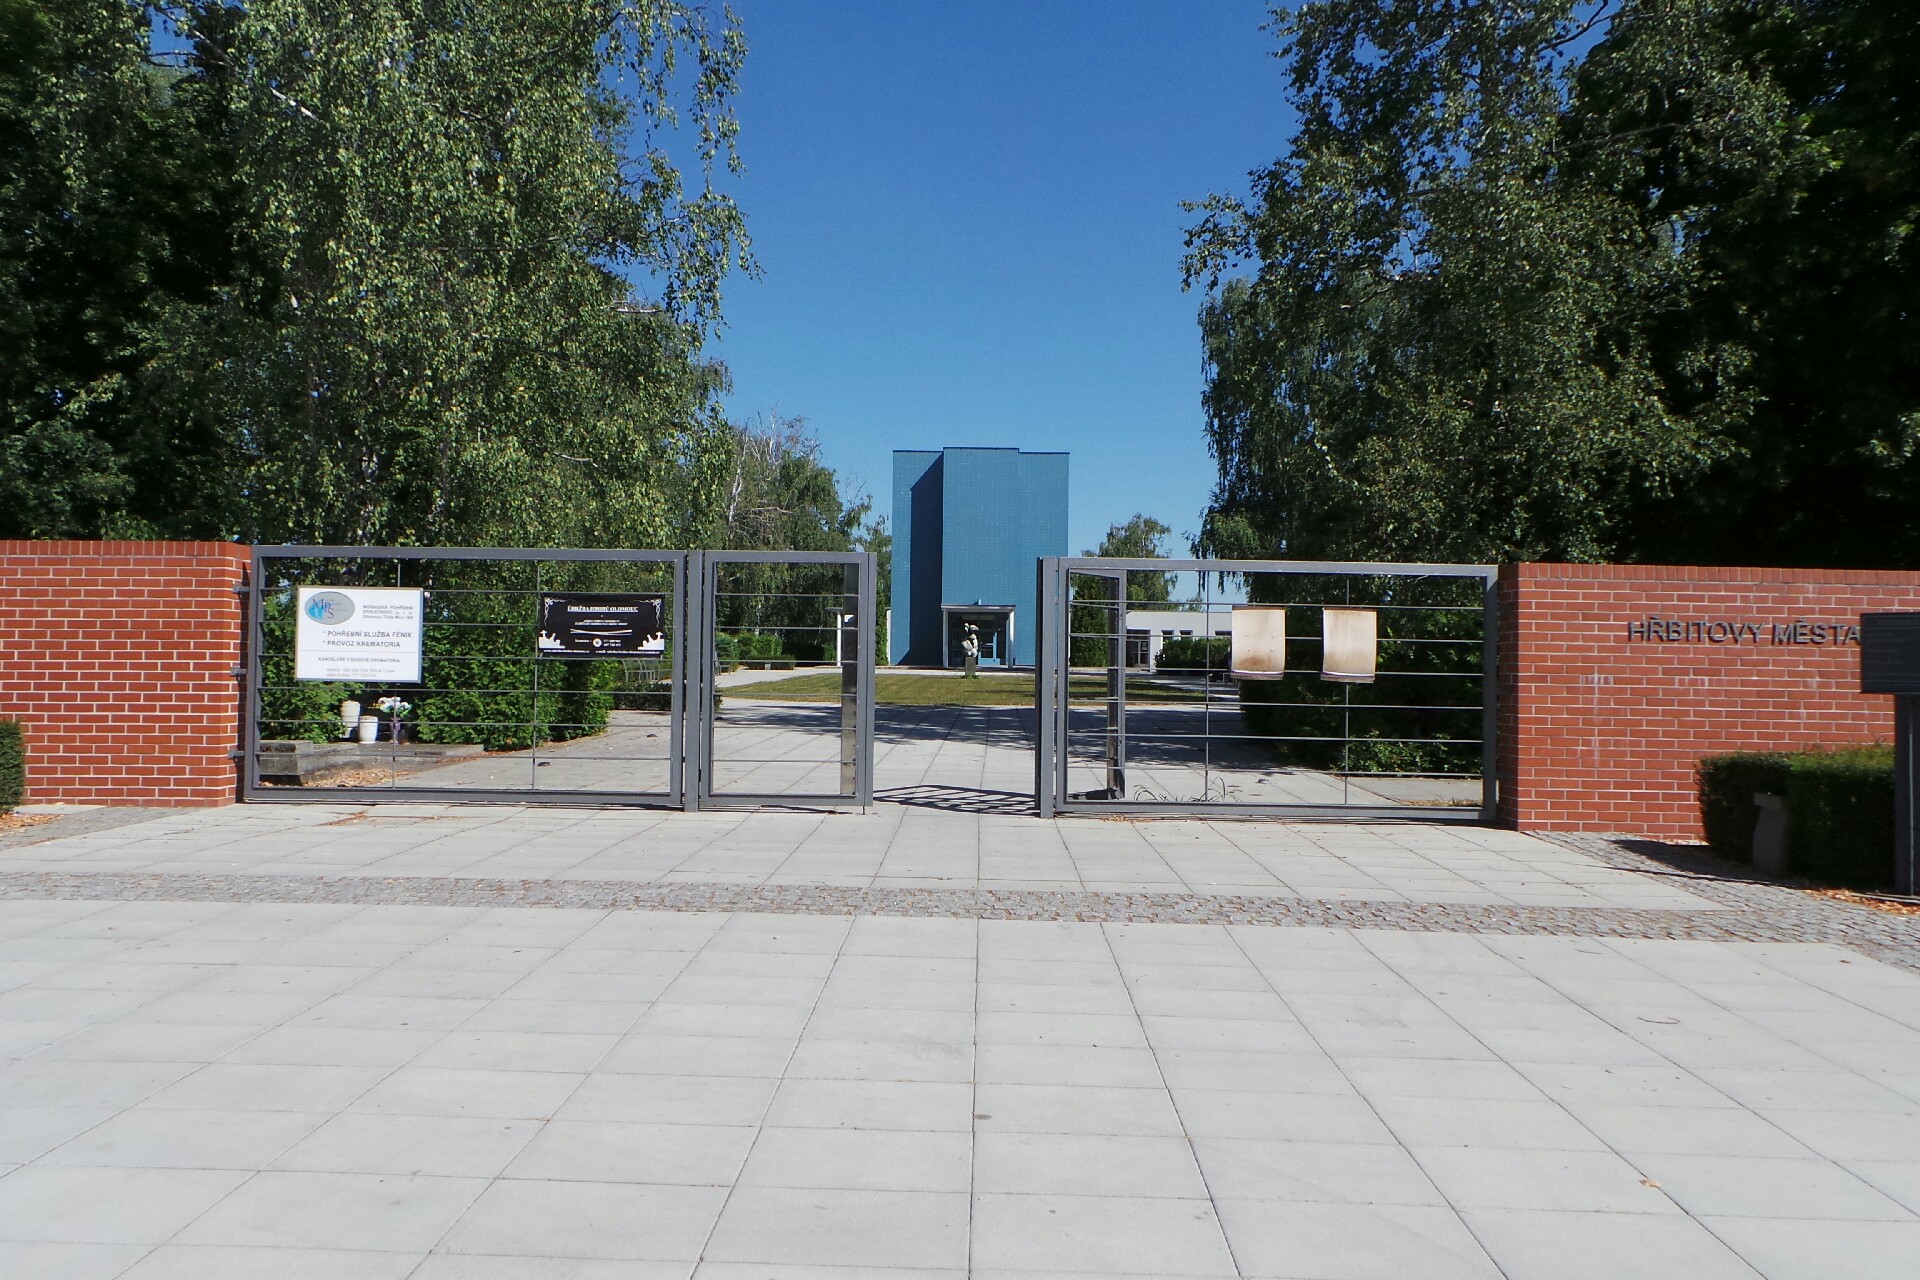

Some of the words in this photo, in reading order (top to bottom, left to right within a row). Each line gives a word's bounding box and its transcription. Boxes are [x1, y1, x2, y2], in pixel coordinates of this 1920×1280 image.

[363, 630, 390, 638] SLUŽBA
[1628, 616, 1764, 643] HŘBITOVY
[1771, 618, 1860, 645] MĚSTA
